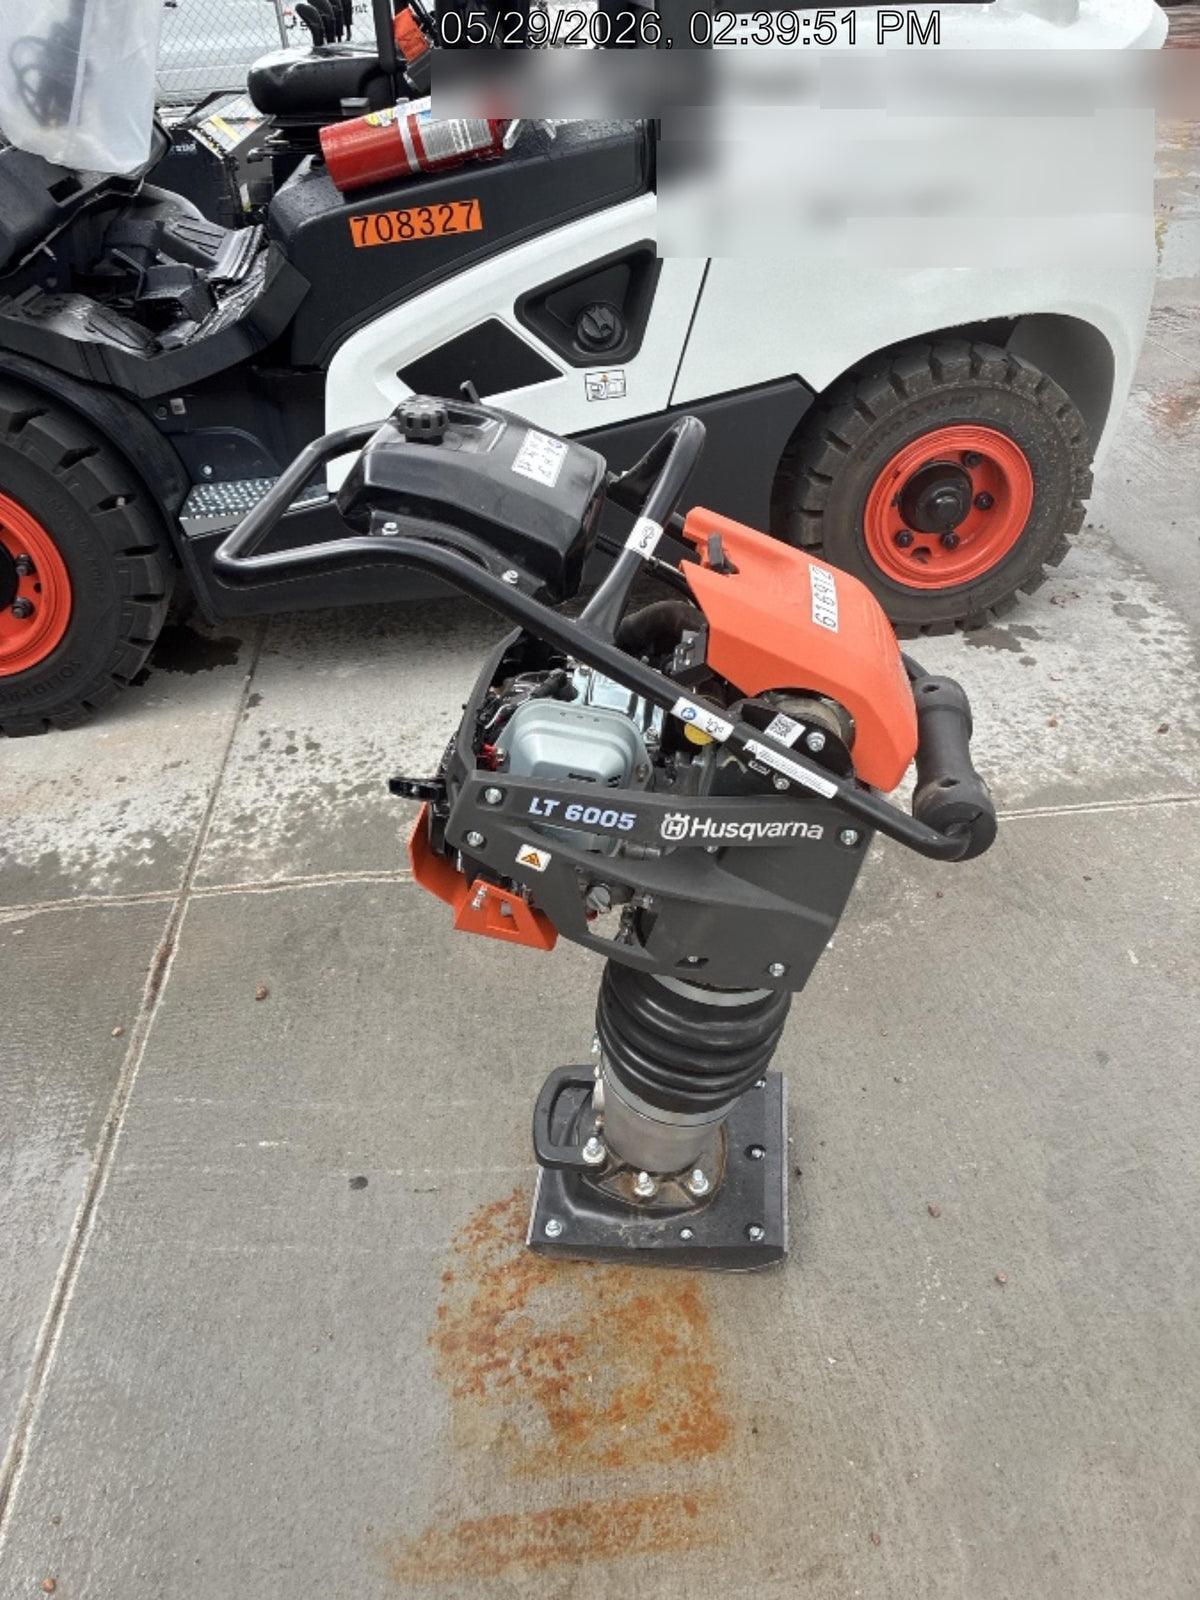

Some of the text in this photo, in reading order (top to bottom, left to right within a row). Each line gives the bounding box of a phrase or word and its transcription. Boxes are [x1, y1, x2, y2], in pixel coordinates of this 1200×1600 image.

[353, 202, 474, 244] 708327
[528, 797, 637, 830] LT 6005
[689, 817, 824, 841] Husqvarna
